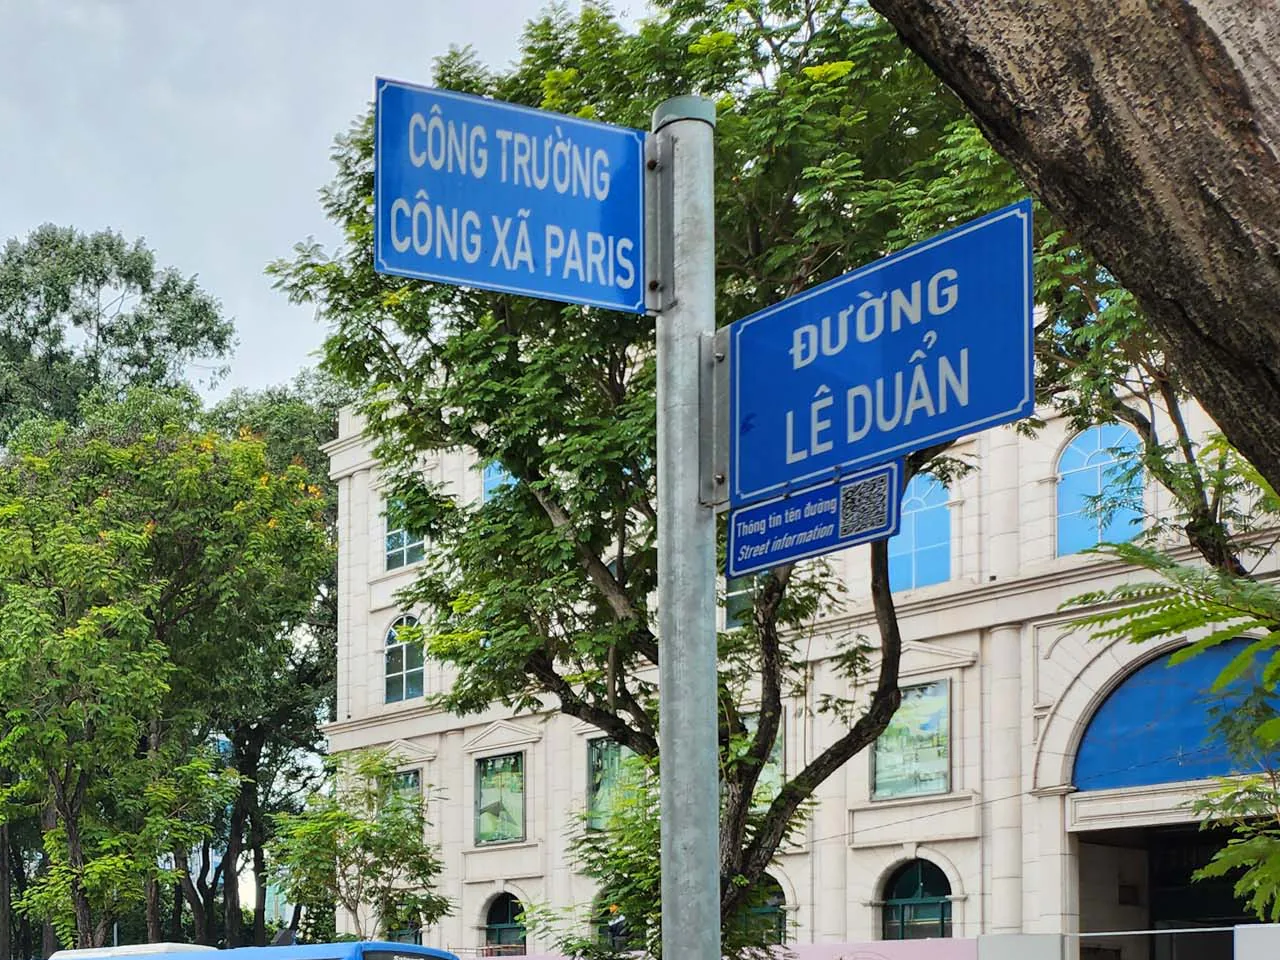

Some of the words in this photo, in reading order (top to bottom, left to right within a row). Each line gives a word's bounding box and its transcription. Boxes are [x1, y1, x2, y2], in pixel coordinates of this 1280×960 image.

[408, 103, 489, 179] CÔNG
[496, 125, 611, 202] TRƯỜNG
[390, 189, 482, 264] CÔNG
[490, 208, 535, 274] XÃ
[545, 224, 635, 290] PARIS
[788, 268, 959, 371] ĐƯỜNG
[786, 384, 834, 465] LÊ
[847, 330, 969, 444] DUẨN
[737, 518, 766, 538] Thông
[768, 511, 782, 528] tin
[785, 504, 801, 523] tên
[737, 542, 769, 562] Street
[771, 523, 836, 552] information
